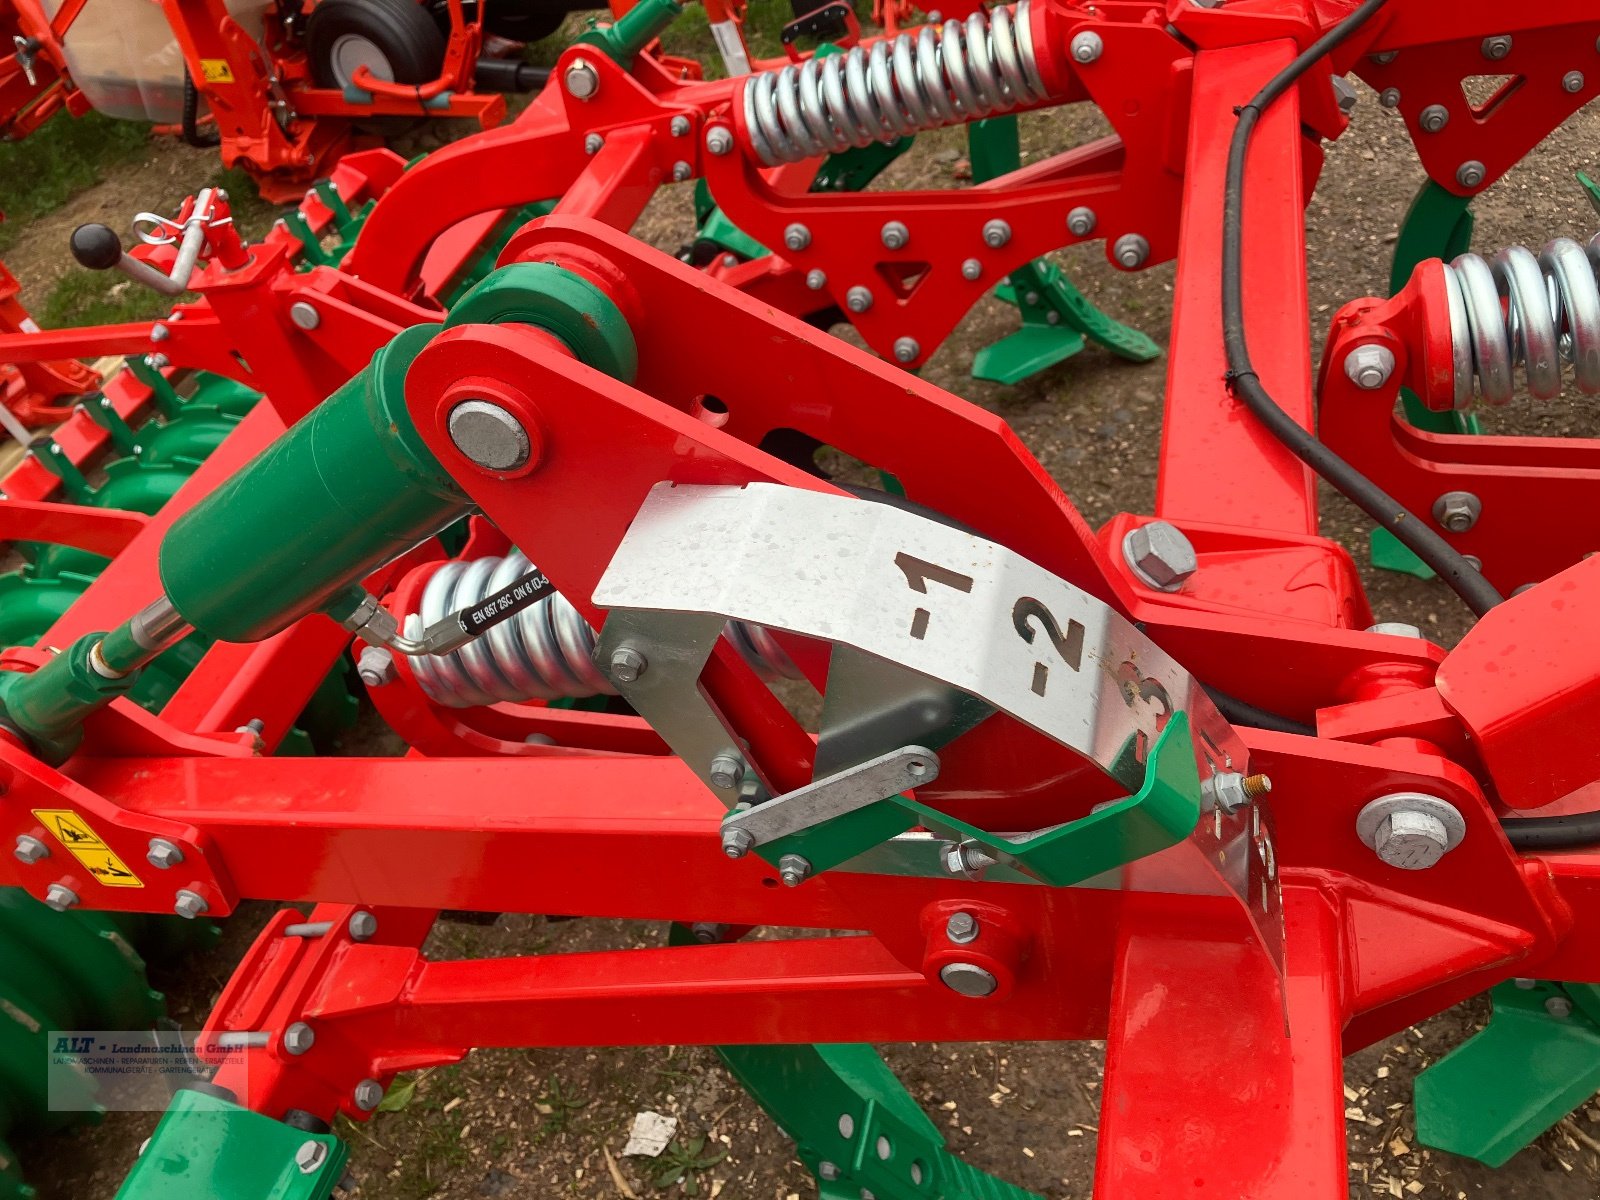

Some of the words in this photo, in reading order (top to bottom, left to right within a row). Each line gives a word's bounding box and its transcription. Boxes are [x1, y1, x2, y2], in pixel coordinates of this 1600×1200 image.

[472, 609, 487, 625] EN
[484, 601, 499, 618] 857
[497, 593, 514, 610] 2SC
[525, 582, 533, 594] 8
[894, 551, 974, 640] -1
[1012, 596, 1085, 698] -2
[1118, 660, 1175, 764] -3
